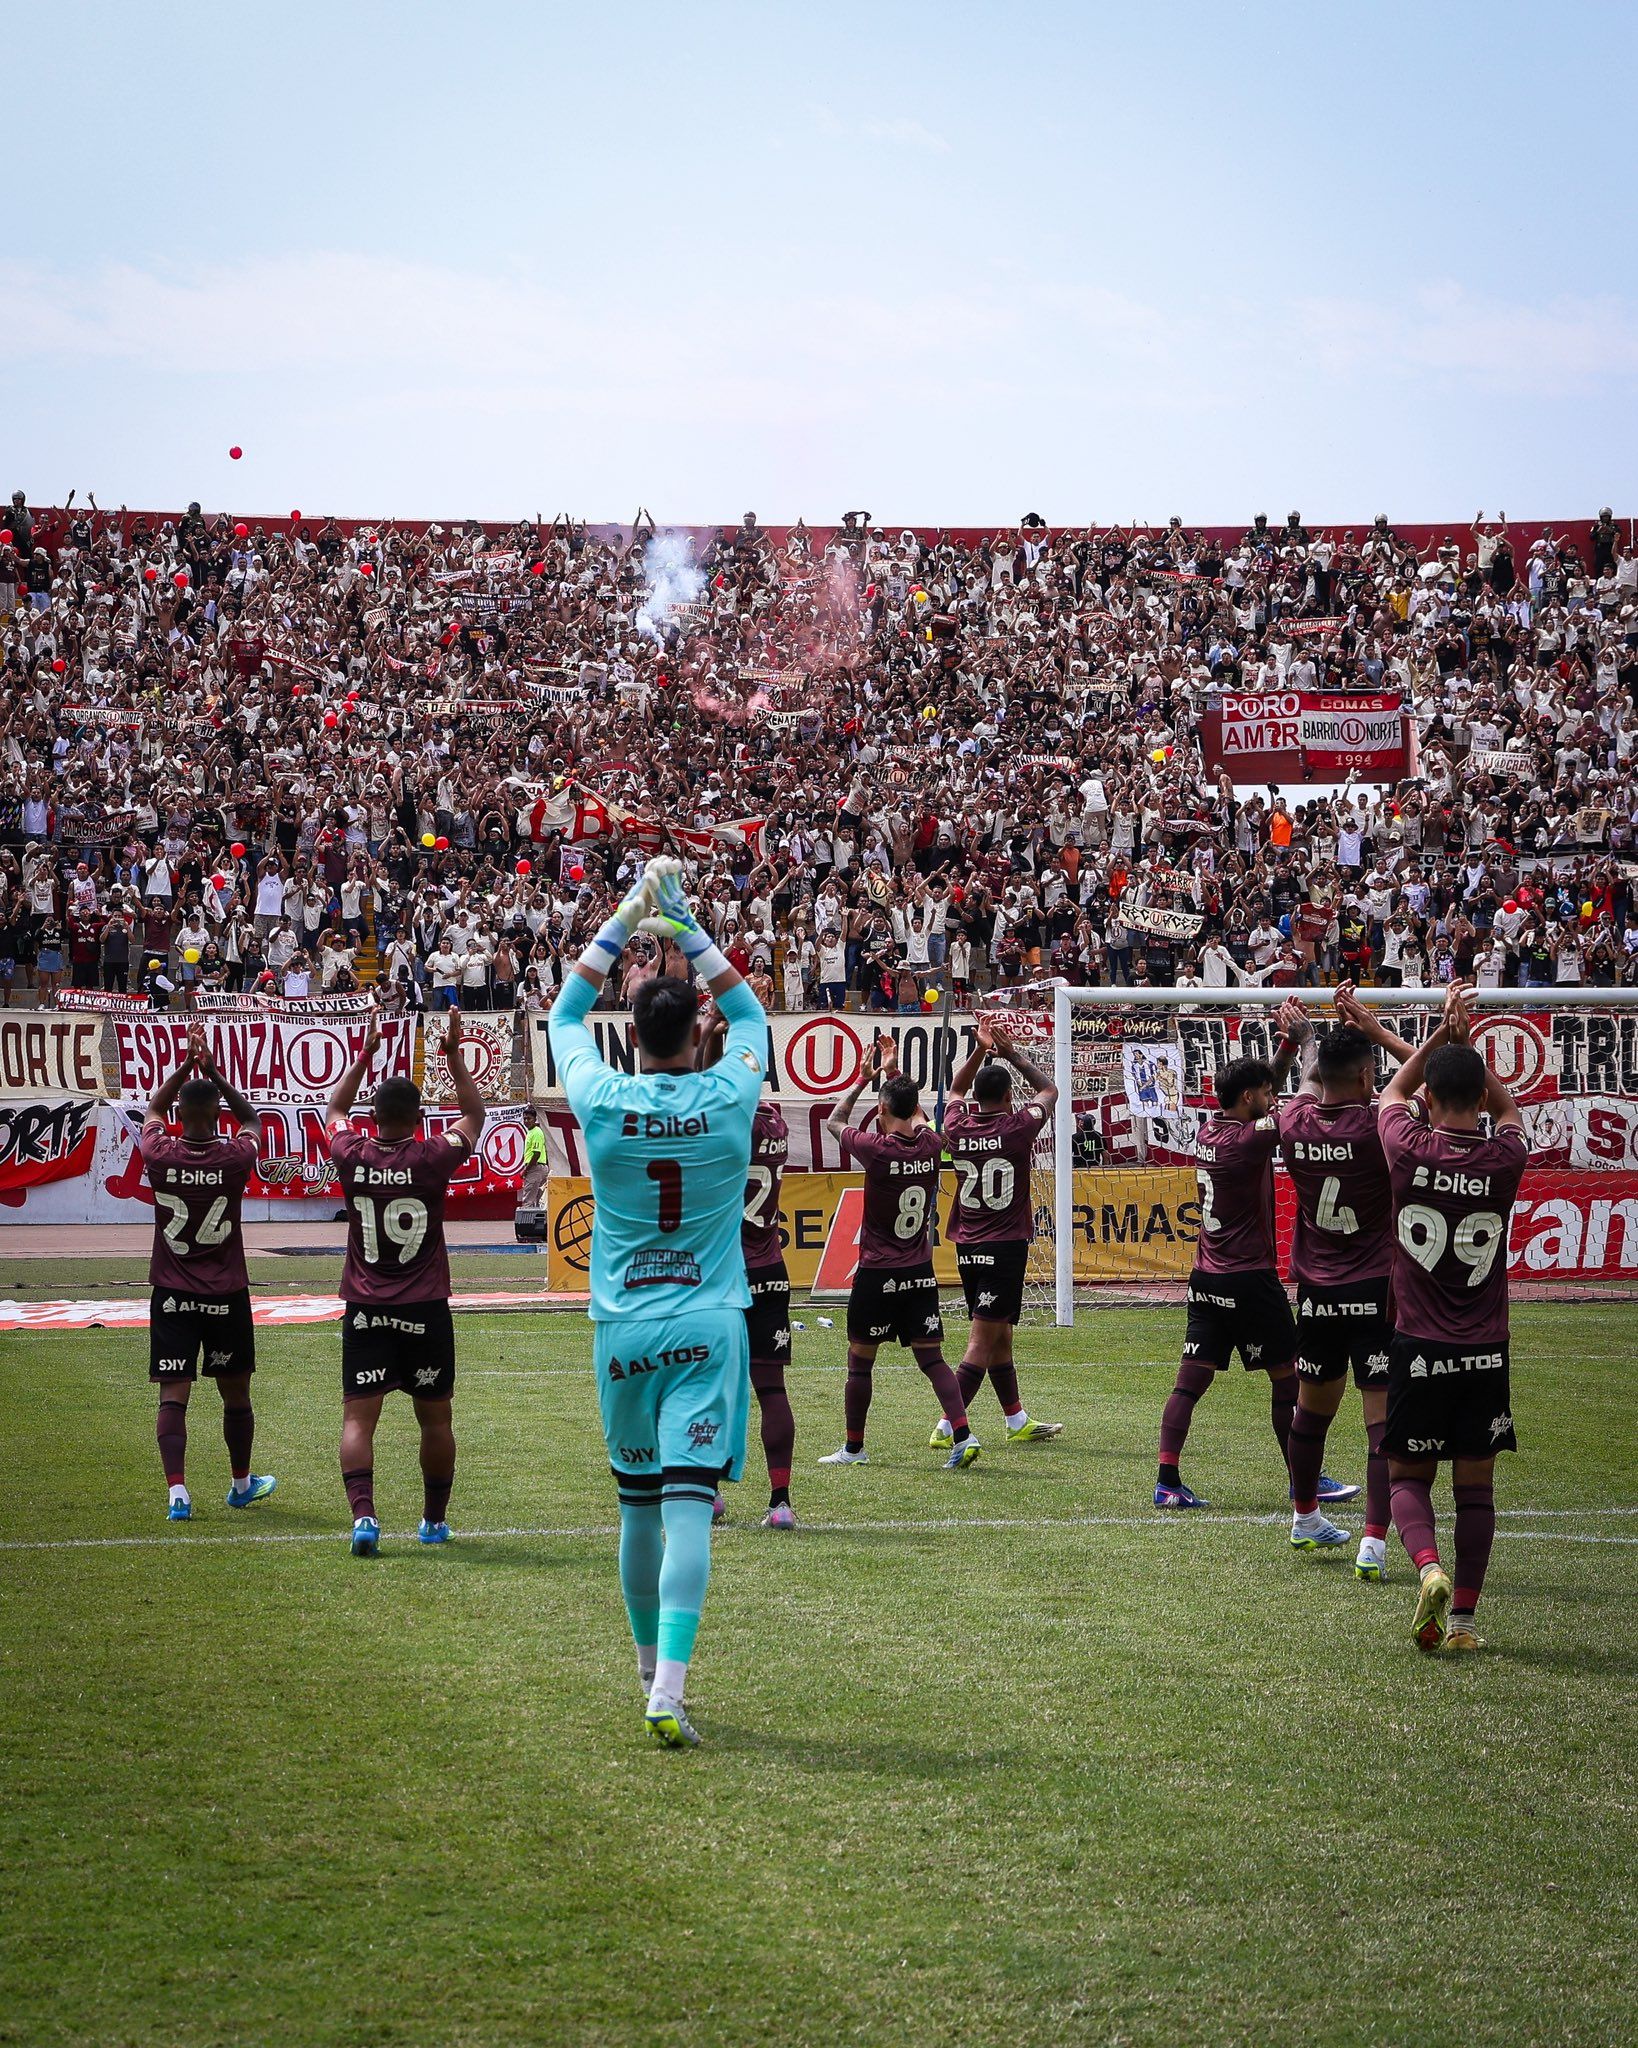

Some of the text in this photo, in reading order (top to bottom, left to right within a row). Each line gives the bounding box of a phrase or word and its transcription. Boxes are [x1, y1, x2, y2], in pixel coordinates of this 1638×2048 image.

[1320, 699, 1383, 710] COMAS
[121, 711, 142, 724] NORTE
[1303, 721, 1340, 740] BARRIO
[1366, 720, 1400, 740] NORTE
[1335, 754, 1373, 766] 1994
[113, 1014, 159, 1024] SEPULTURA
[216, 1014, 264, 1024] SUPUESTOS
[270, 1015, 315, 1026] LUNATICOS
[323, 1015, 372, 1026] SUPERIORES
[115, 1022, 288, 1092] ESPEANZA
[646, 1112, 709, 1139] bitel
[968, 1136, 1002, 1151] bitel
[1083, 1140, 1096, 1151] 911
[1308, 1142, 1353, 1162] bitel
[903, 1157, 934, 1175] bitel
[181, 1169, 223, 1185] bitel
[368, 1167, 413, 1185] bitel
[953, 1157, 1014, 1211] 20
[1434, 1169, 1491, 1196] bitel
[646, 1159, 682, 1234] 1
[894, 1185, 926, 1239] 8
[1316, 1176, 1359, 1234] 4
[353, 1196, 429, 1264] 19
[1398, 1204, 1504, 1287] 99
[959, 1254, 995, 1265] ALTOS
[750, 1280, 789, 1295] ALTOS
[898, 1277, 937, 1293] ALTOS
[179, 1301, 229, 1316] ALTOS
[1195, 1293, 1236, 1309] ALTOS
[1315, 1303, 1378, 1317] ALTOS
[370, 1315, 426, 1335] ALTOS
[1183, 1342, 1199, 1355] KY
[159, 1359, 187, 1371] SKY
[628, 1344, 710, 1377] ALTOS
[1367, 1355, 1389, 1364] Electr
[1431, 1352, 1503, 1375] ALTOS
[356, 1368, 387, 1385] SKY
[688, 1421, 720, 1434] Electro
[692, 1432, 713, 1446] light
[1408, 1438, 1445, 1453] SKY
[620, 1447, 656, 1463] SKY
